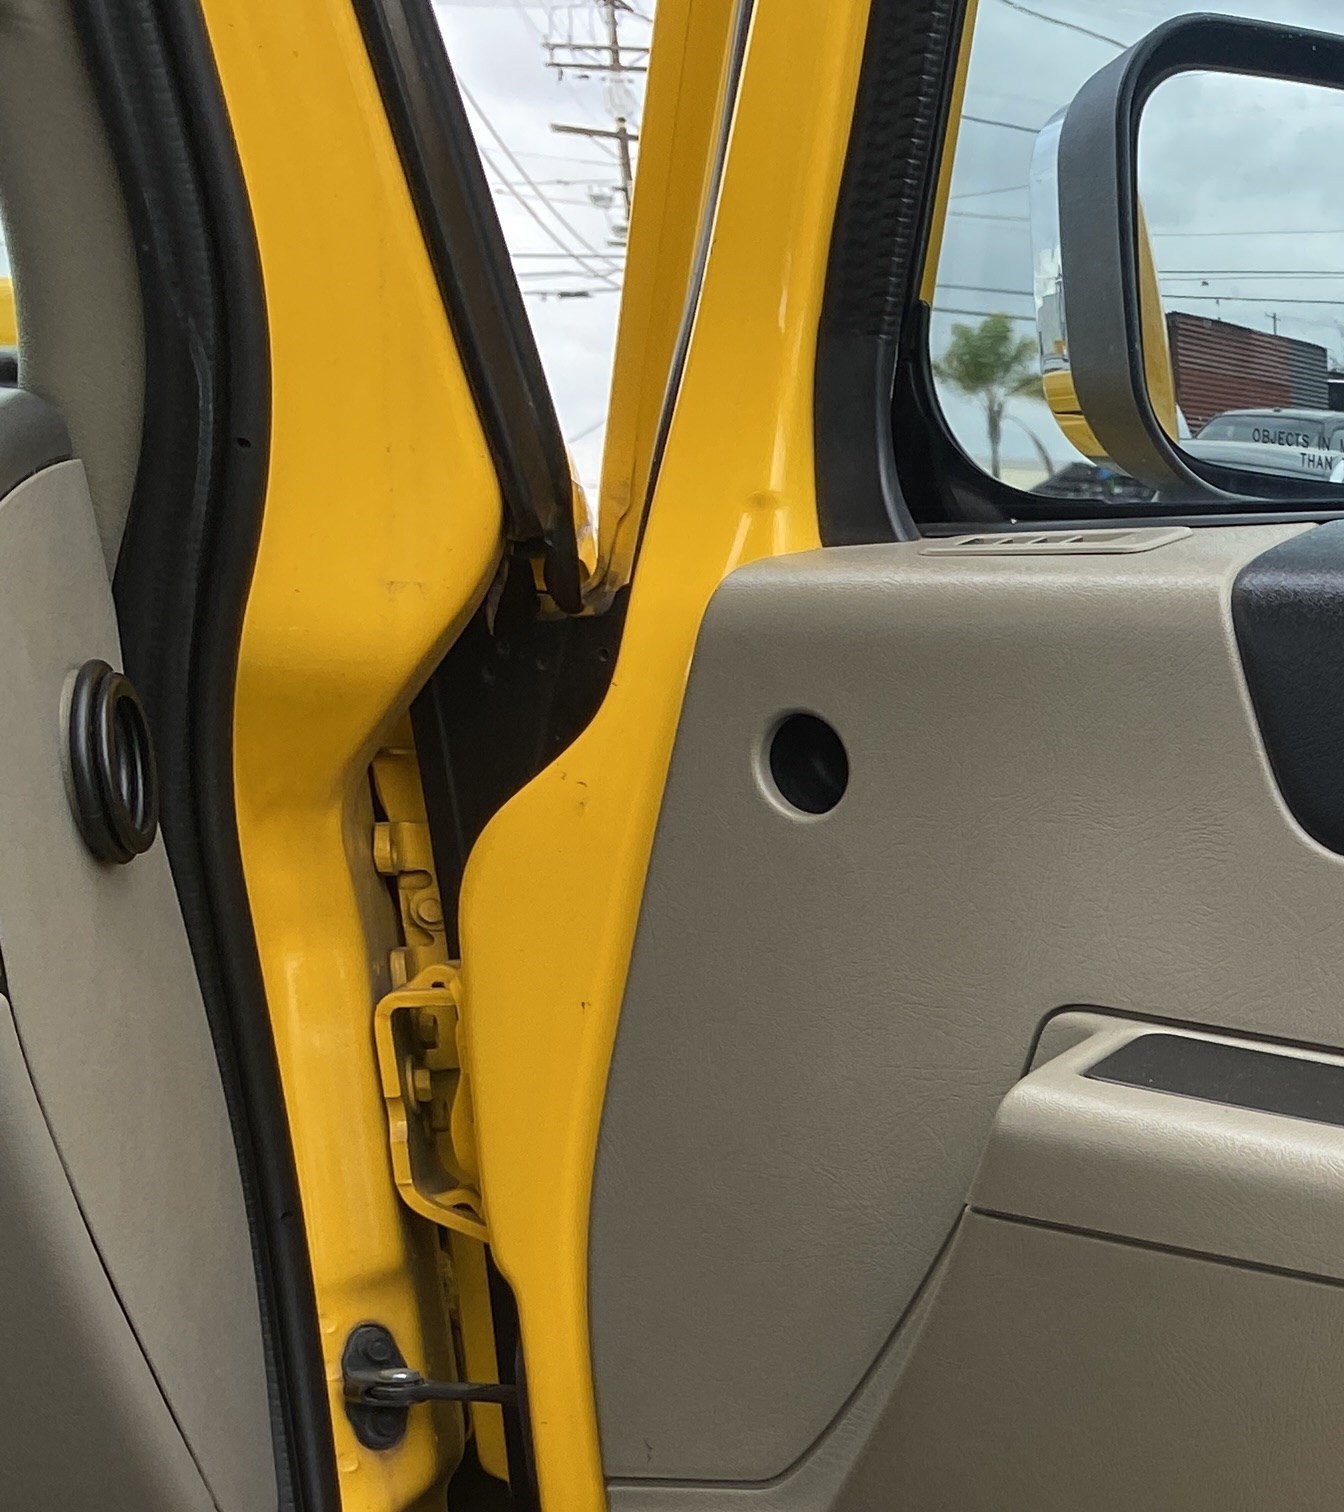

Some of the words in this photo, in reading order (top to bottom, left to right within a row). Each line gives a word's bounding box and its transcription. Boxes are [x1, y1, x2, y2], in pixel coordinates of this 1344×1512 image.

[1252, 428, 1310, 448] OBJECTS
[1317, 436, 1330, 450] IN
[1300, 452, 1333, 470] THAN
